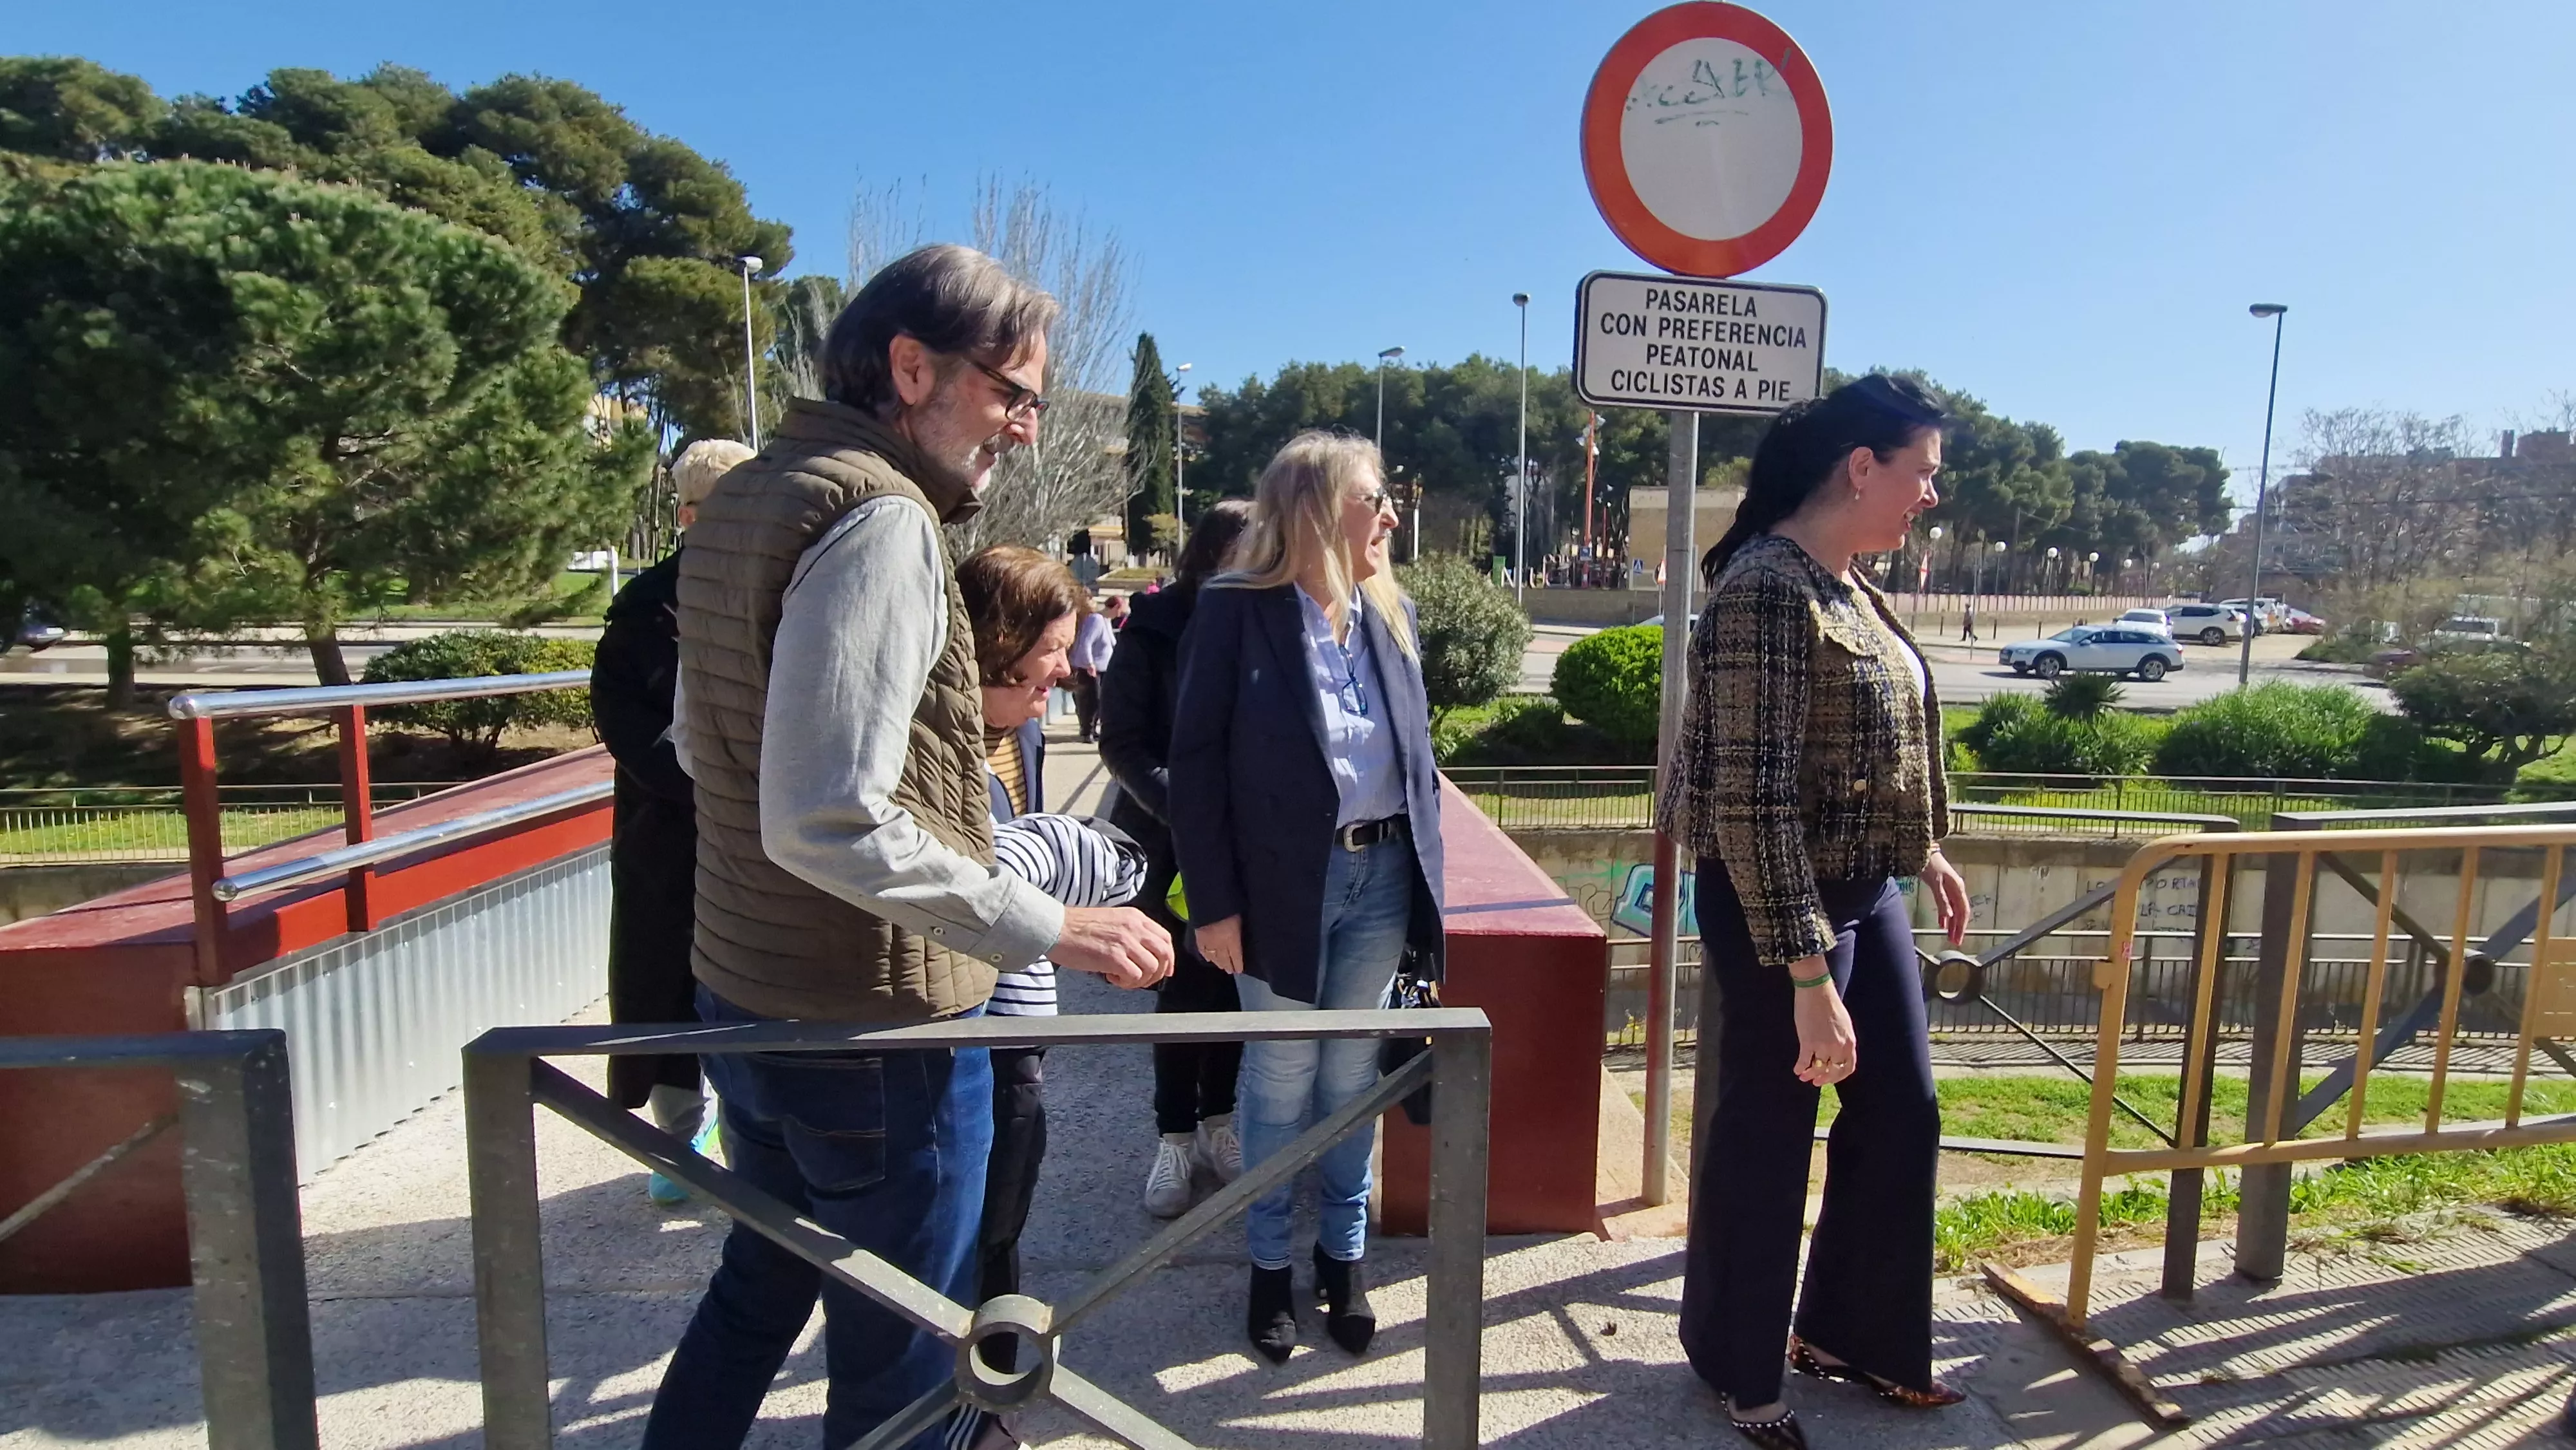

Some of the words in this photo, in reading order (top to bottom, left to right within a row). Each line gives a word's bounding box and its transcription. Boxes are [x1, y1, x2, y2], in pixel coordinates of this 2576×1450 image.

[1646, 288, 1757, 317] PASARELA
[1600, 312, 1647, 337] CON
[1658, 316, 1806, 348] PREFERENCIA
[1647, 343, 1759, 372] PEATONAL
[1611, 369, 1725, 398] CICLISTAS
[1734, 378, 1747, 399] A
[1757, 379, 1791, 402] PIE
